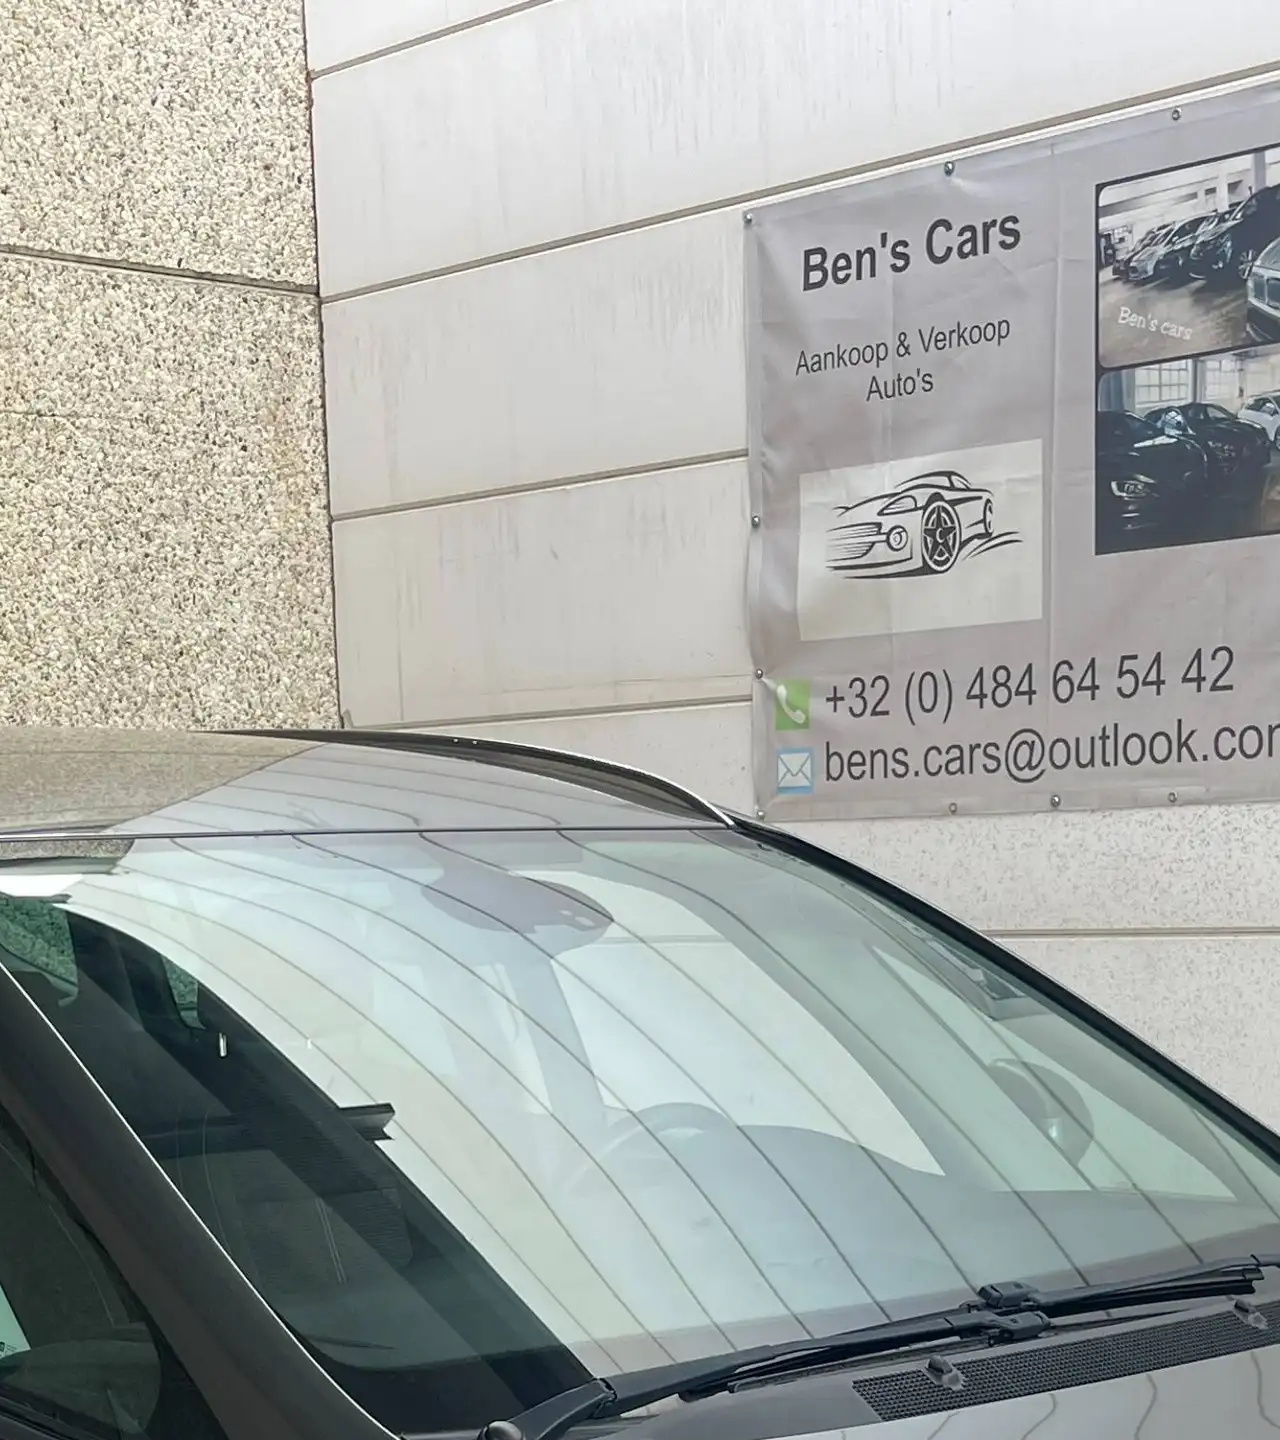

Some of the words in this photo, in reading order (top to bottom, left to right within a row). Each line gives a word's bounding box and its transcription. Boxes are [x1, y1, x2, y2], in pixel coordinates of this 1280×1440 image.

[802, 231, 911, 292] Ben's
[925, 214, 1021, 265] Cars
[795, 341, 889, 377] Aankoop
[895, 331, 912, 358] &
[917, 318, 1011, 353] Verkoop
[1117, 306, 1158, 332] Ben's
[865, 367, 934, 402] Auto's
[825, 674, 890, 719] +32
[904, 668, 953, 727] (0)
[965, 662, 1038, 710] 484
[1052, 656, 1101, 704] 64
[1116, 651, 1166, 700] 54
[1180, 645, 1234, 694] 42
